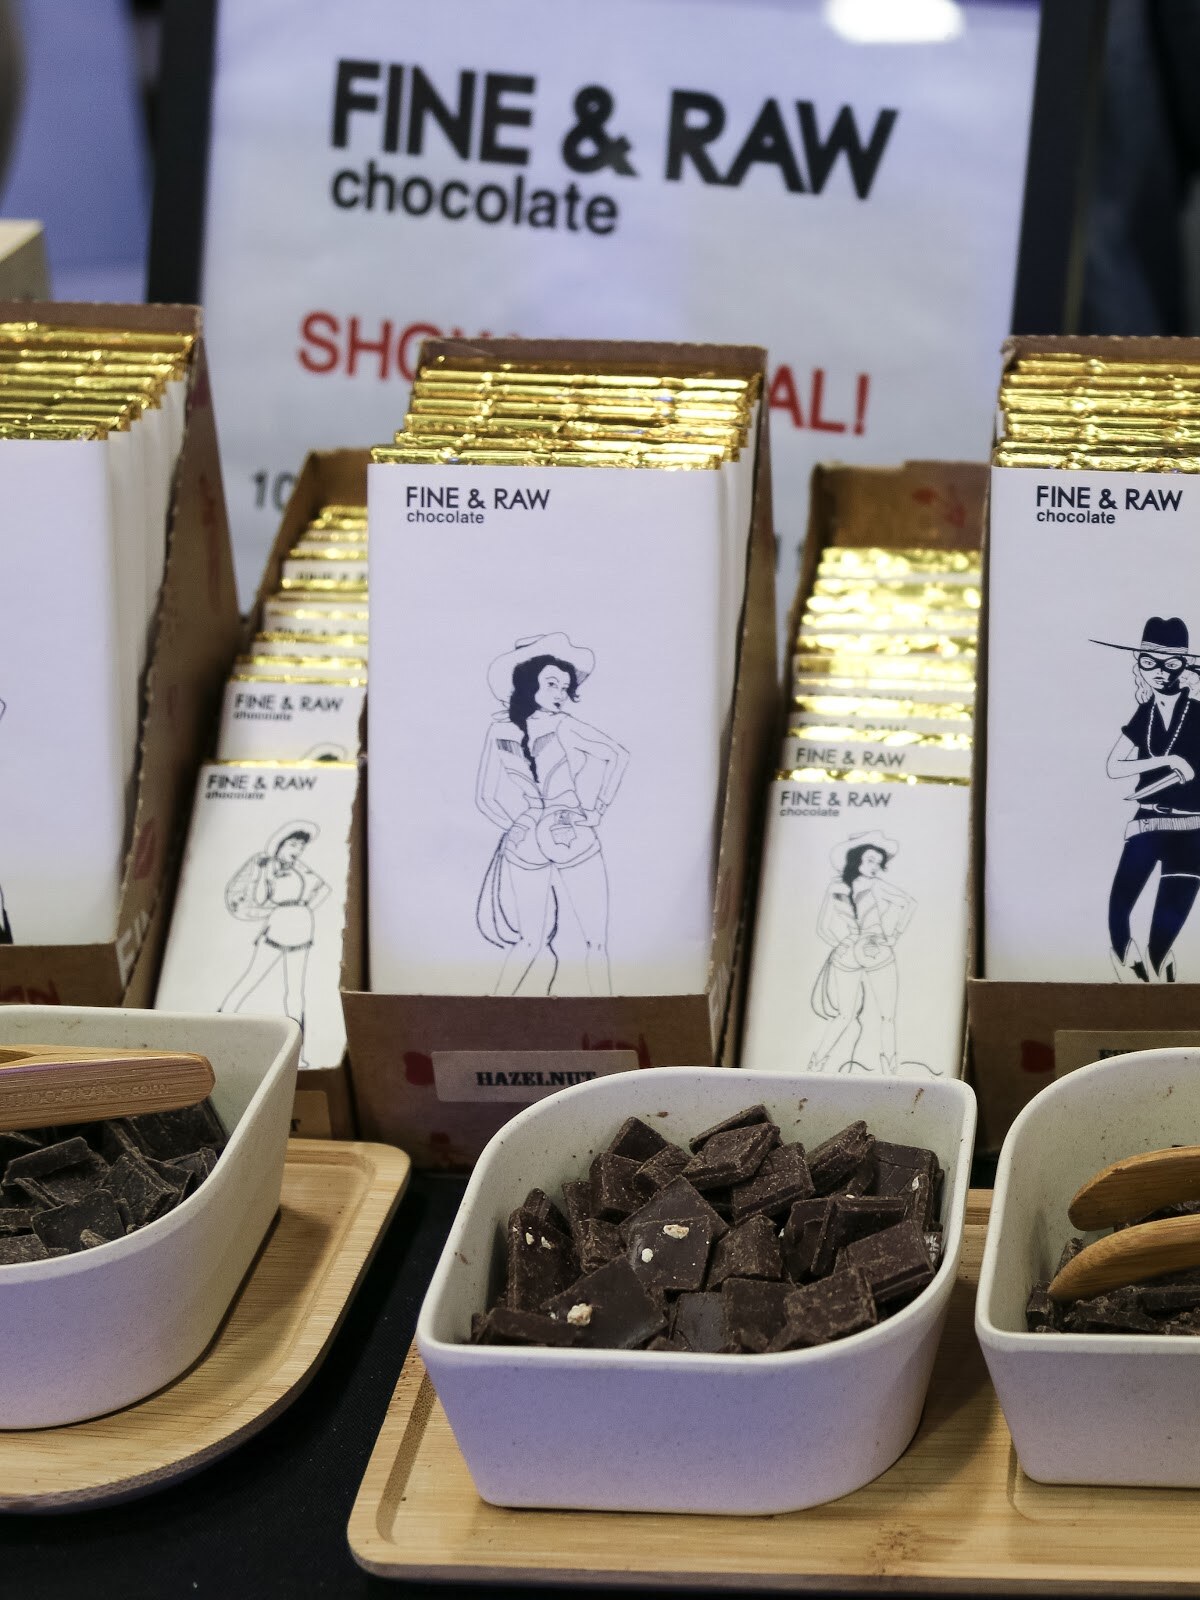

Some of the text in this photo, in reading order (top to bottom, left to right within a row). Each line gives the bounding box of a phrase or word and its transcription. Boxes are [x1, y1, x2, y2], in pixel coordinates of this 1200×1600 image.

[331, 59, 900, 201] FINE & RAW
[332, 159, 619, 236] chocolate
[298, 311, 518, 382] SHO
[406, 486, 551, 510] FINE & RAW
[1036, 485, 1183, 511] FINE & RAW
[407, 509, 485, 524] chocolate
[1036, 509, 1116, 524] chocolate
[234, 693, 344, 711] FINE & RAW
[796, 747, 837, 764] FINE
[842, 750, 855, 765] &
[862, 750, 906, 767] RAW
[207, 774, 318, 791] FINE & RAW
[780, 790, 892, 807] FINE & RAW
[779, 806, 840, 817] chocolate
